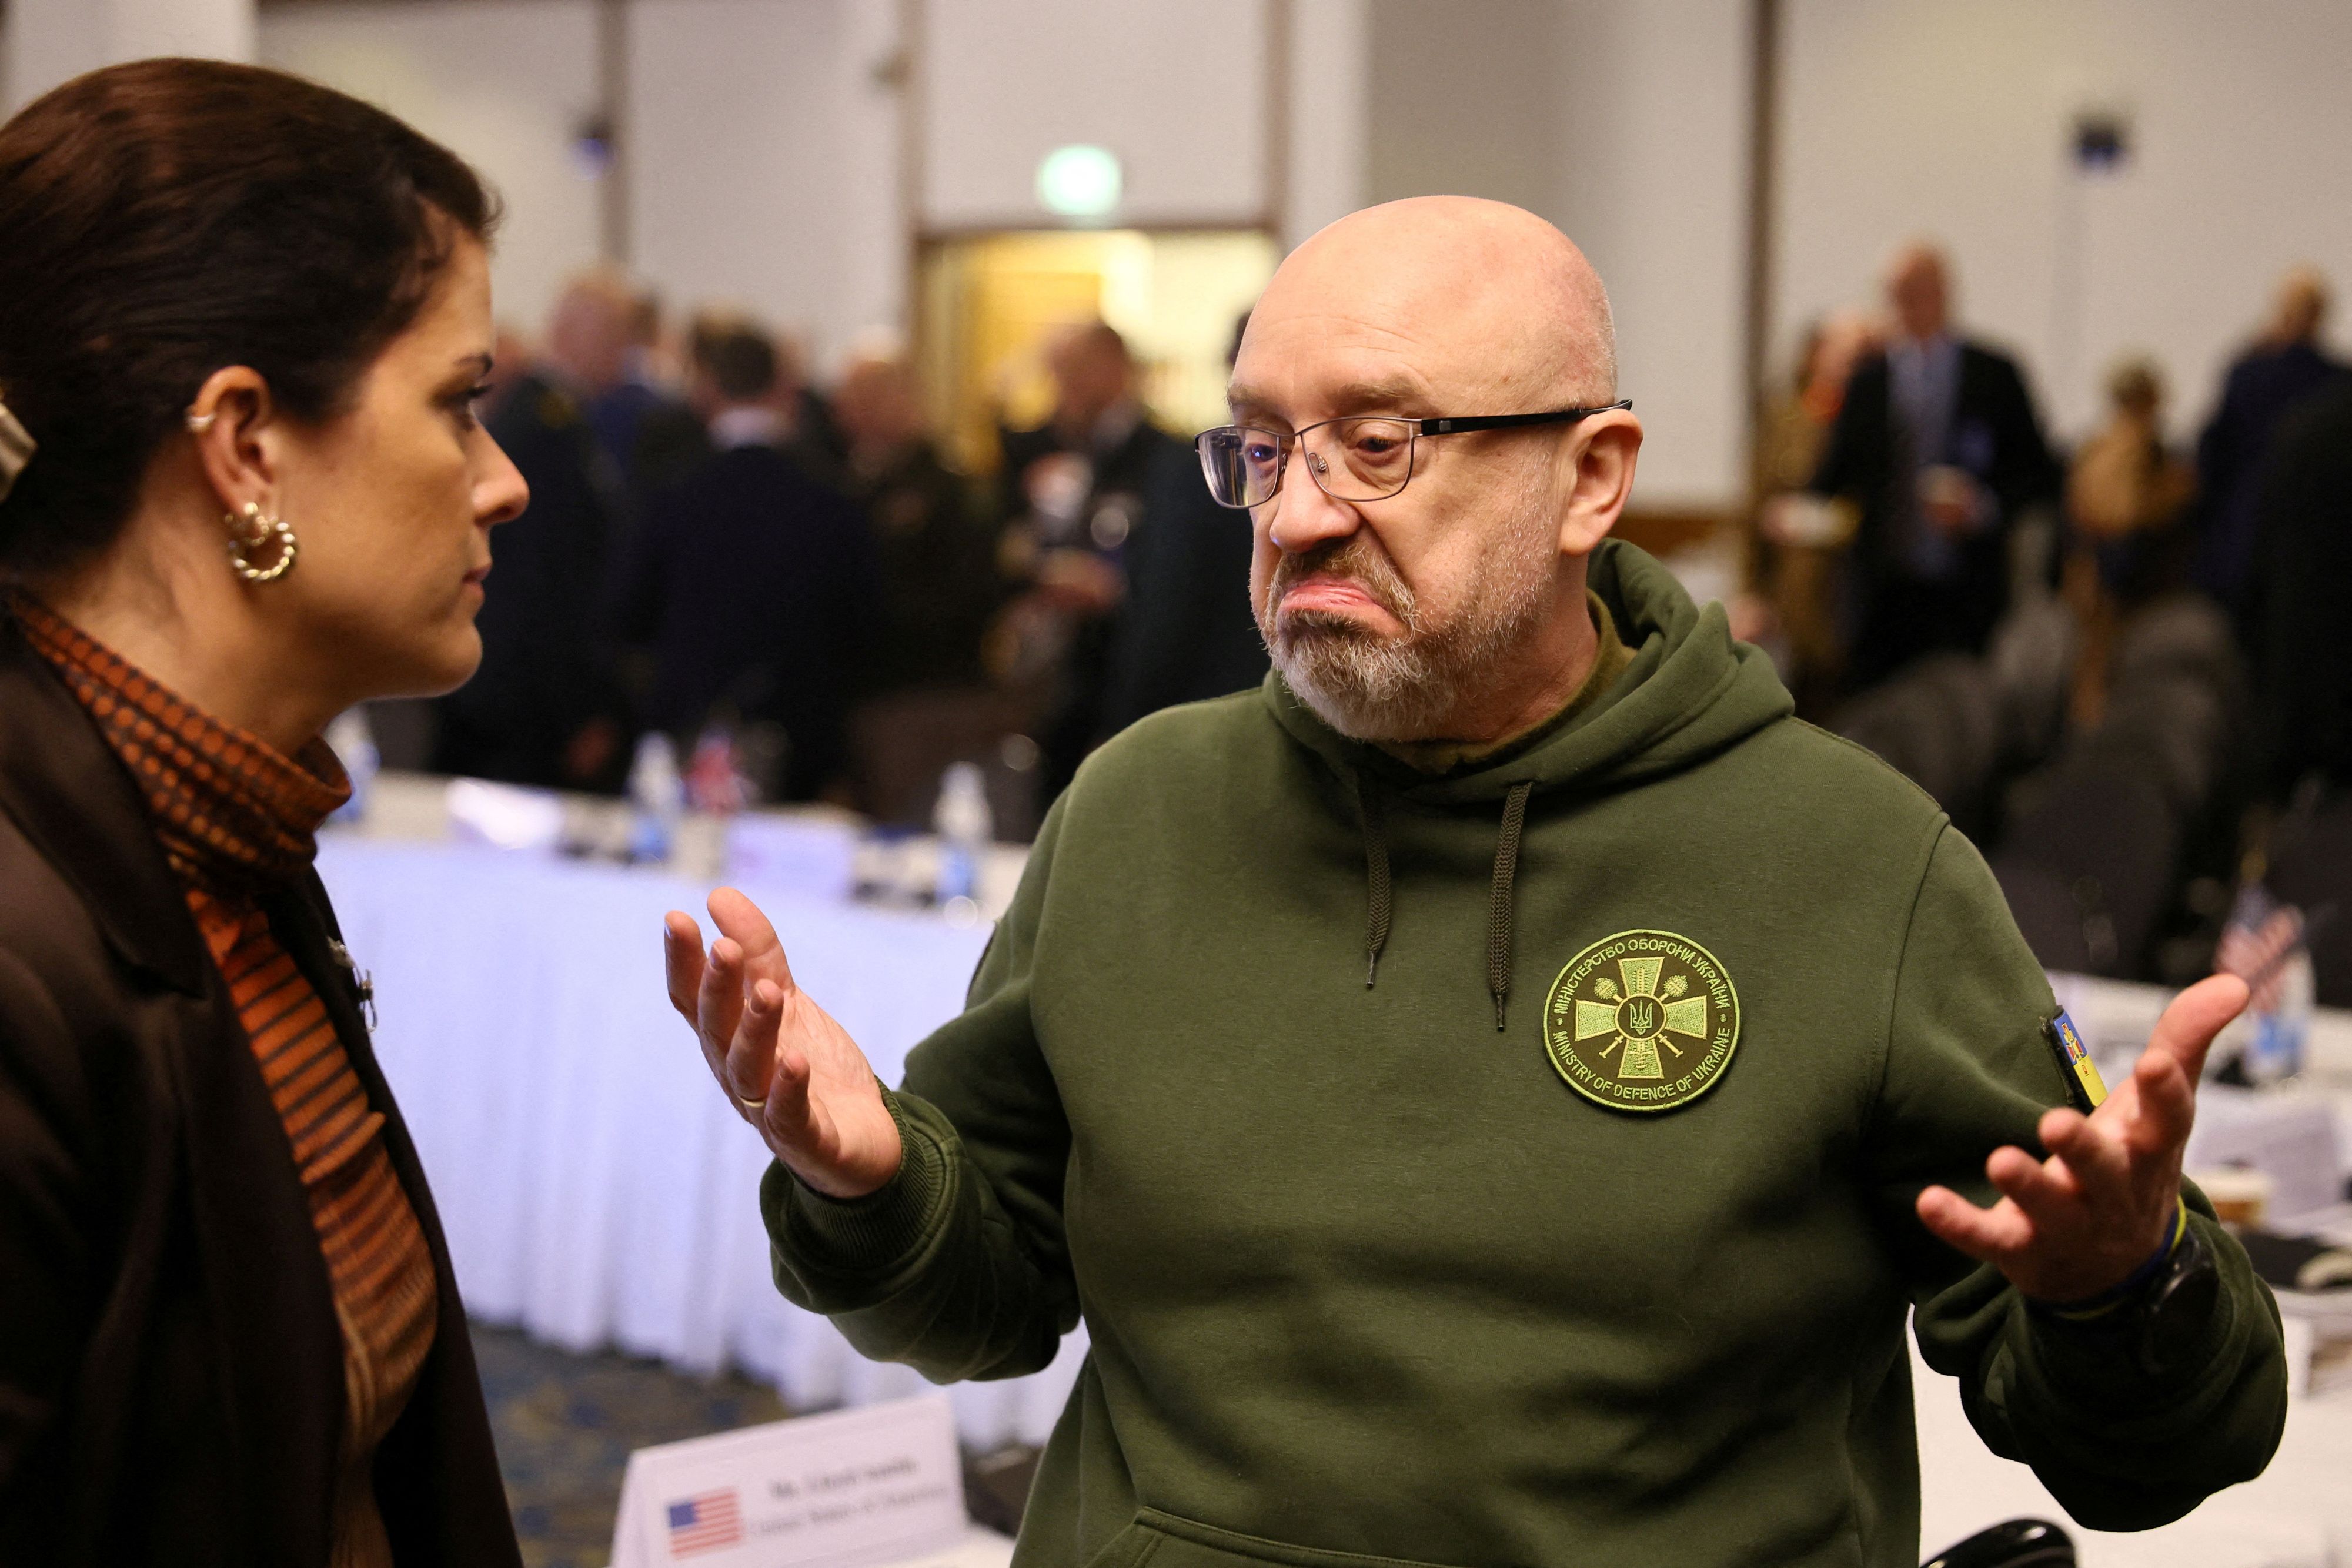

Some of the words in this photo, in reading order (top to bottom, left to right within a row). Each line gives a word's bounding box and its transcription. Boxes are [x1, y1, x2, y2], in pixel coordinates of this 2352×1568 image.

[1553, 942, 1626, 1015] МІНІСТЕРСТВО
[1628, 938, 1696, 964] ОБОРОНИ
[1692, 956, 1731, 1009] УКРАЇНИ
[1552, 1030, 1598, 1083] MINISTRY
[1593, 1076, 1613, 1094] OF
[1613, 1083, 1676, 1101] DEFENCE
[1676, 1074, 1693, 1093] OF
[1692, 1027, 1731, 1082] UKRAINE
